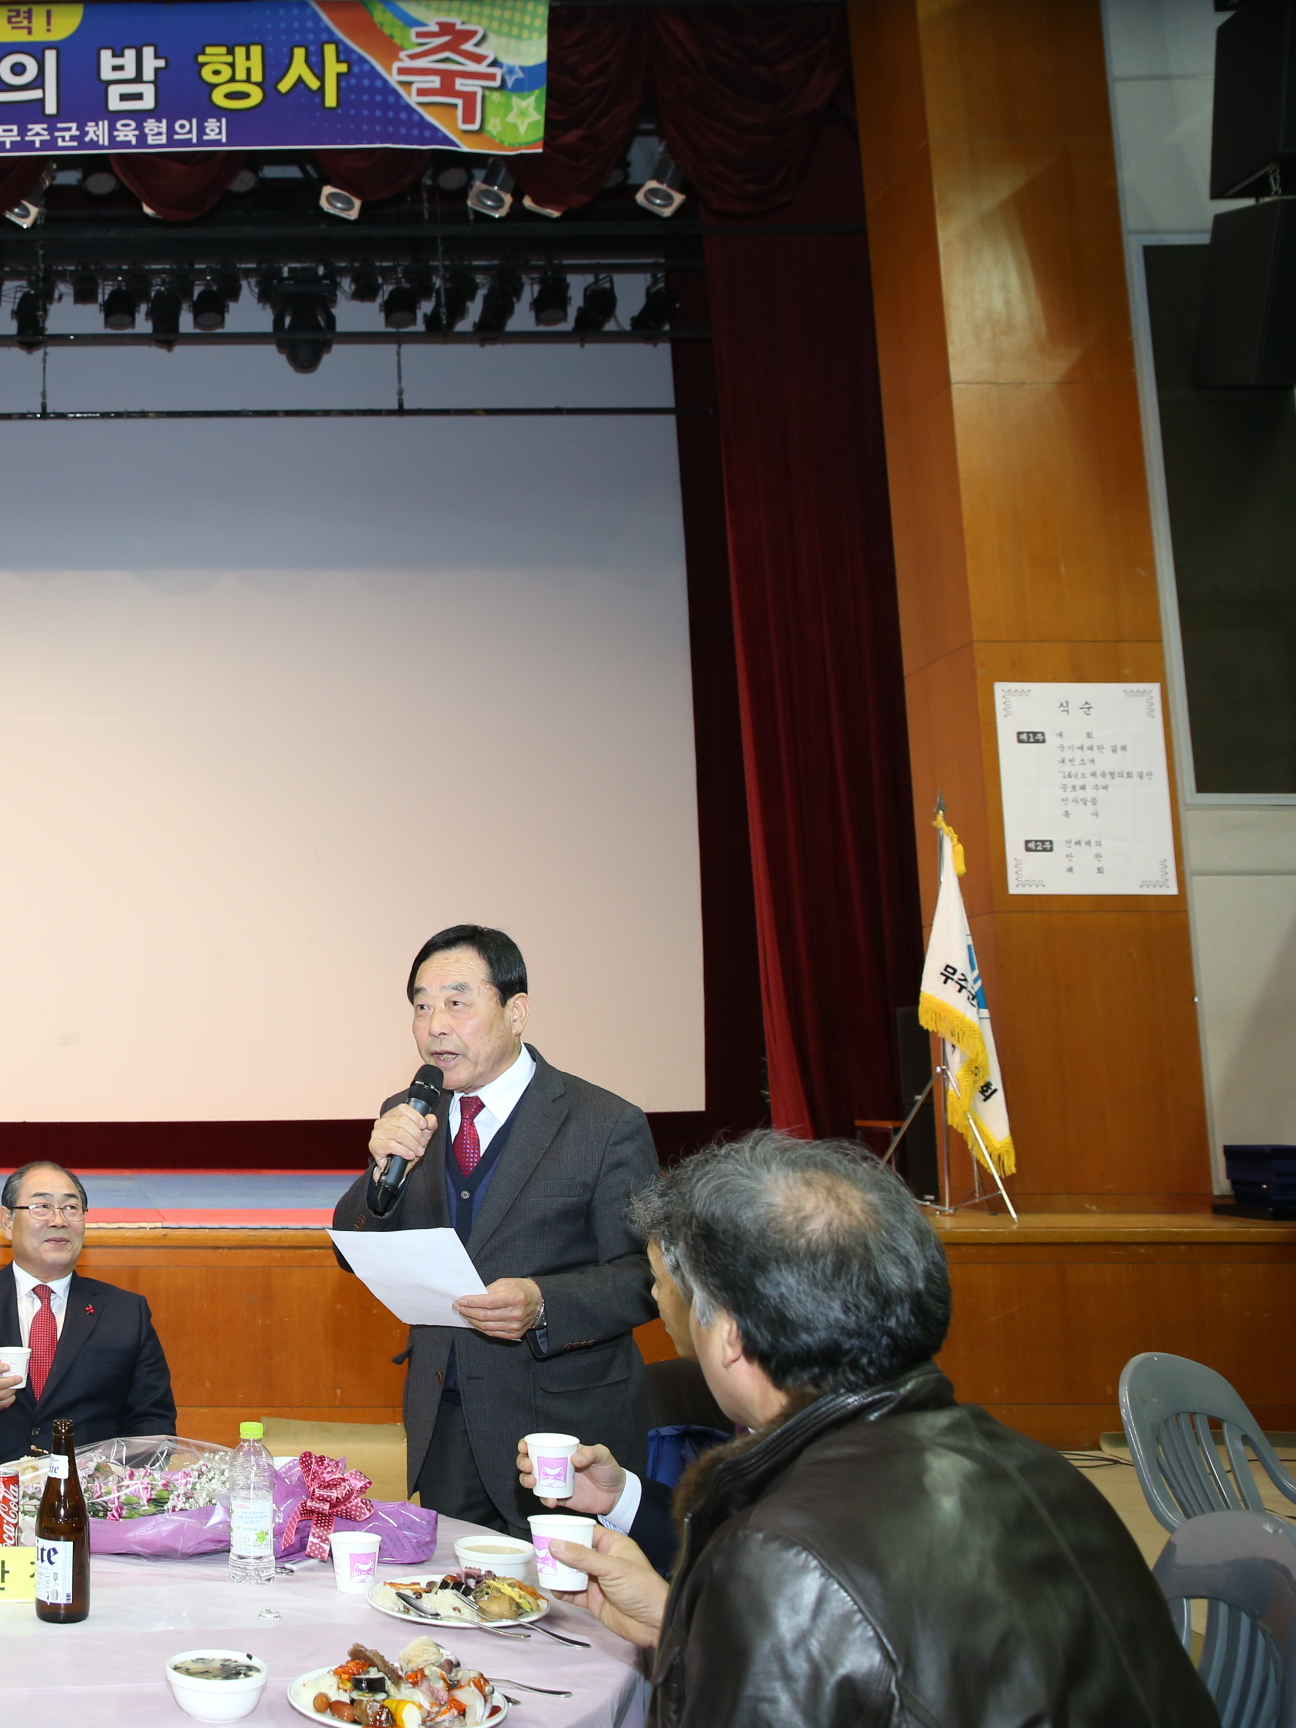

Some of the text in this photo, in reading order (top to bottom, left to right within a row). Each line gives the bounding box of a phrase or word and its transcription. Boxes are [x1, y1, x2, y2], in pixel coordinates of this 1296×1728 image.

[98, 45, 167, 112] 밤
[197, 42, 349, 111] 행사
[392, 18, 502, 131] 축
[1057, 700, 1094, 716] 식 순
[36, 1538, 60, 1566] ite
